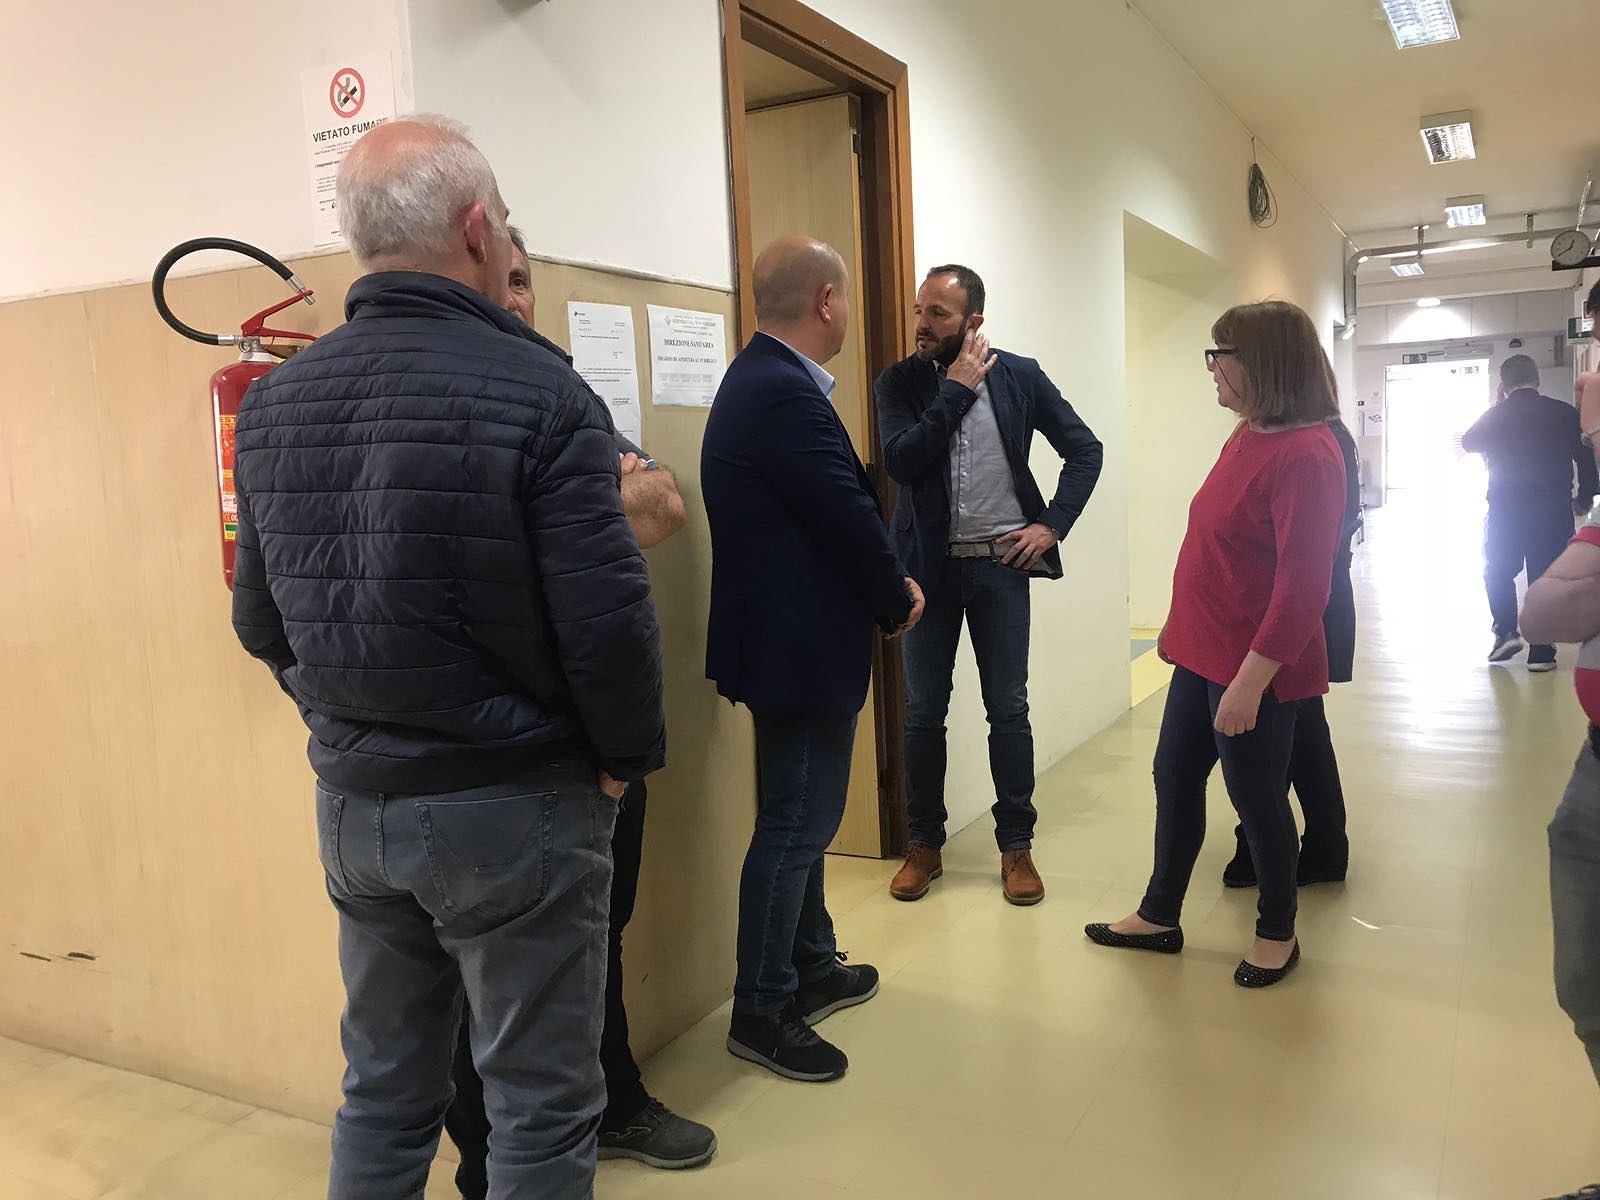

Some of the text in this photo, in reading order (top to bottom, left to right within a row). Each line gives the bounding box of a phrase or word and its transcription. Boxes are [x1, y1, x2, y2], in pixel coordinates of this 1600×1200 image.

[312, 117, 388, 142] VIETATO FUMAR
[664, 339, 690, 347] DIREZIONE
